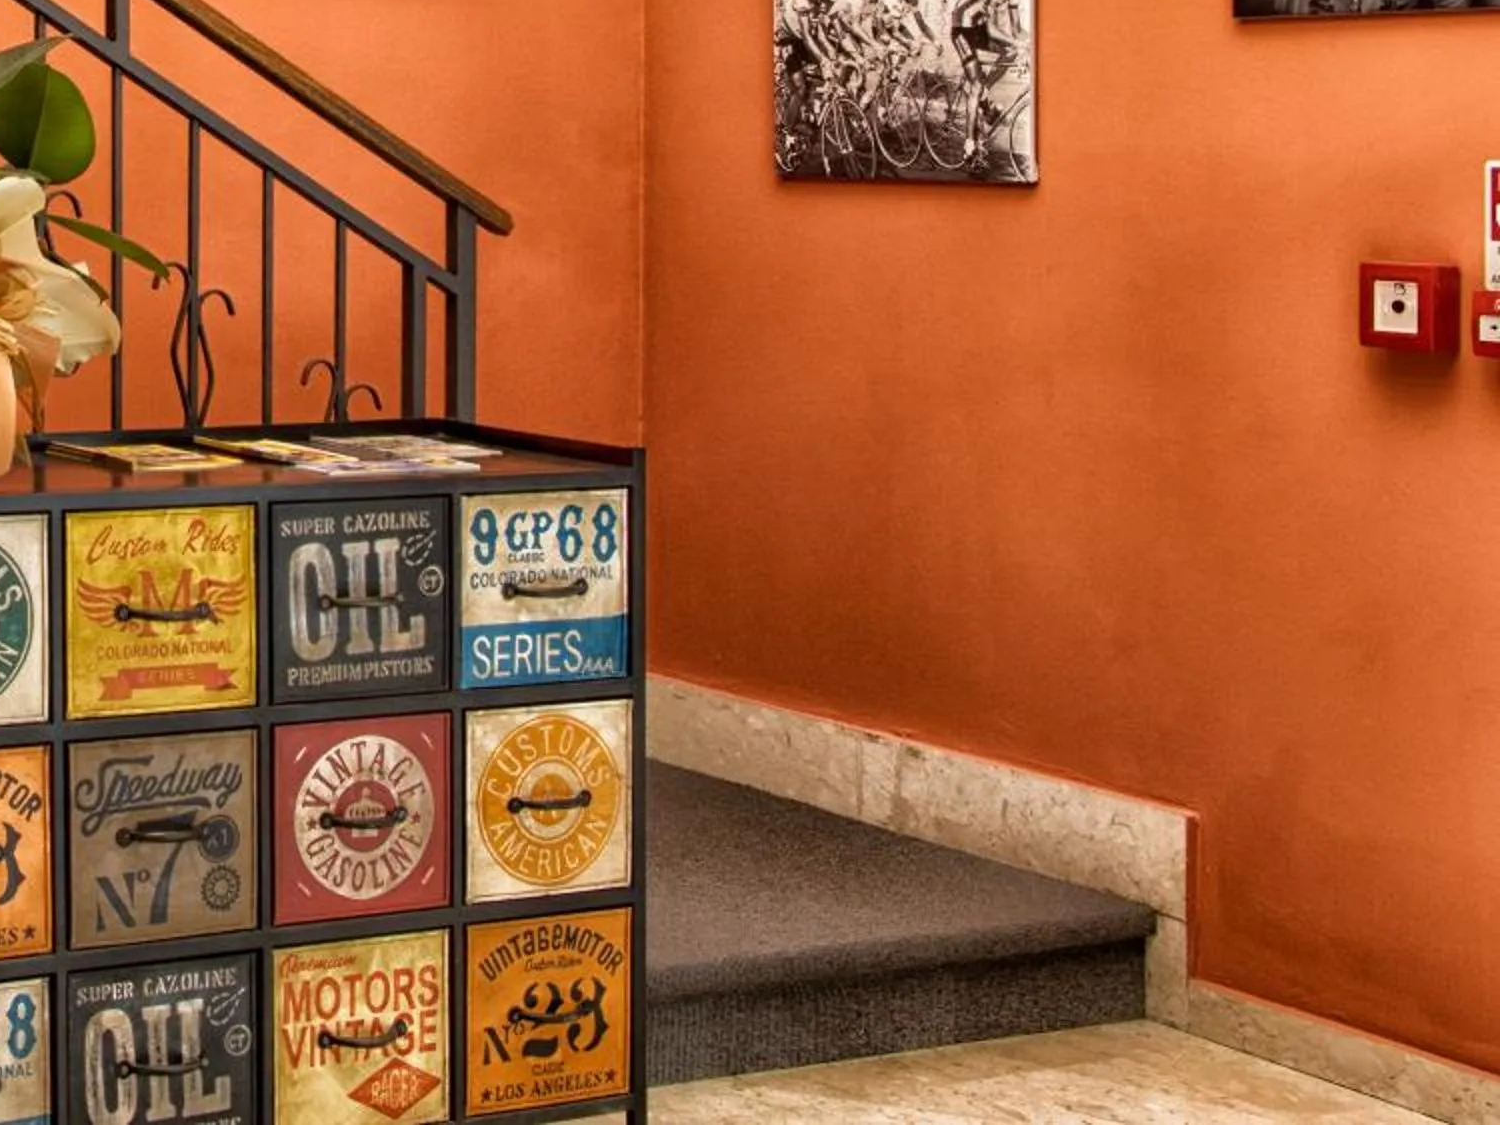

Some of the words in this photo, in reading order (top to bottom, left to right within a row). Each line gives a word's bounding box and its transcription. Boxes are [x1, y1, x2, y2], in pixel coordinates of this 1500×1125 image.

[86, 525, 167, 565] Custom
[182, 519, 241, 556] Rides
[280, 517, 336, 538] SUPER
[289, 538, 425, 663] OIL
[470, 569, 547, 590] COLORADO
[550, 565, 614, 582] NATIONAL
[97, 643, 169, 661] COLORADO
[172, 639, 233, 656] NATIONAL
[472, 629, 583, 679] SERIES
[302, 741, 426, 810] VINTAGE
[487, 725, 611, 799] CUSTOMS
[76, 755, 242, 836] Speedway
[307, 828, 422, 892] GASOLINE
[490, 816, 607, 876] AMERICAN
[77, 982, 134, 1005] SUPER
[283, 965, 439, 1023] MOTORS
[85, 999, 231, 1125] OIL
[282, 1009, 438, 1069] VINTAGE
[495, 1082, 525, 1102] LOS
[530, 1069, 604, 1097] ANGELES
